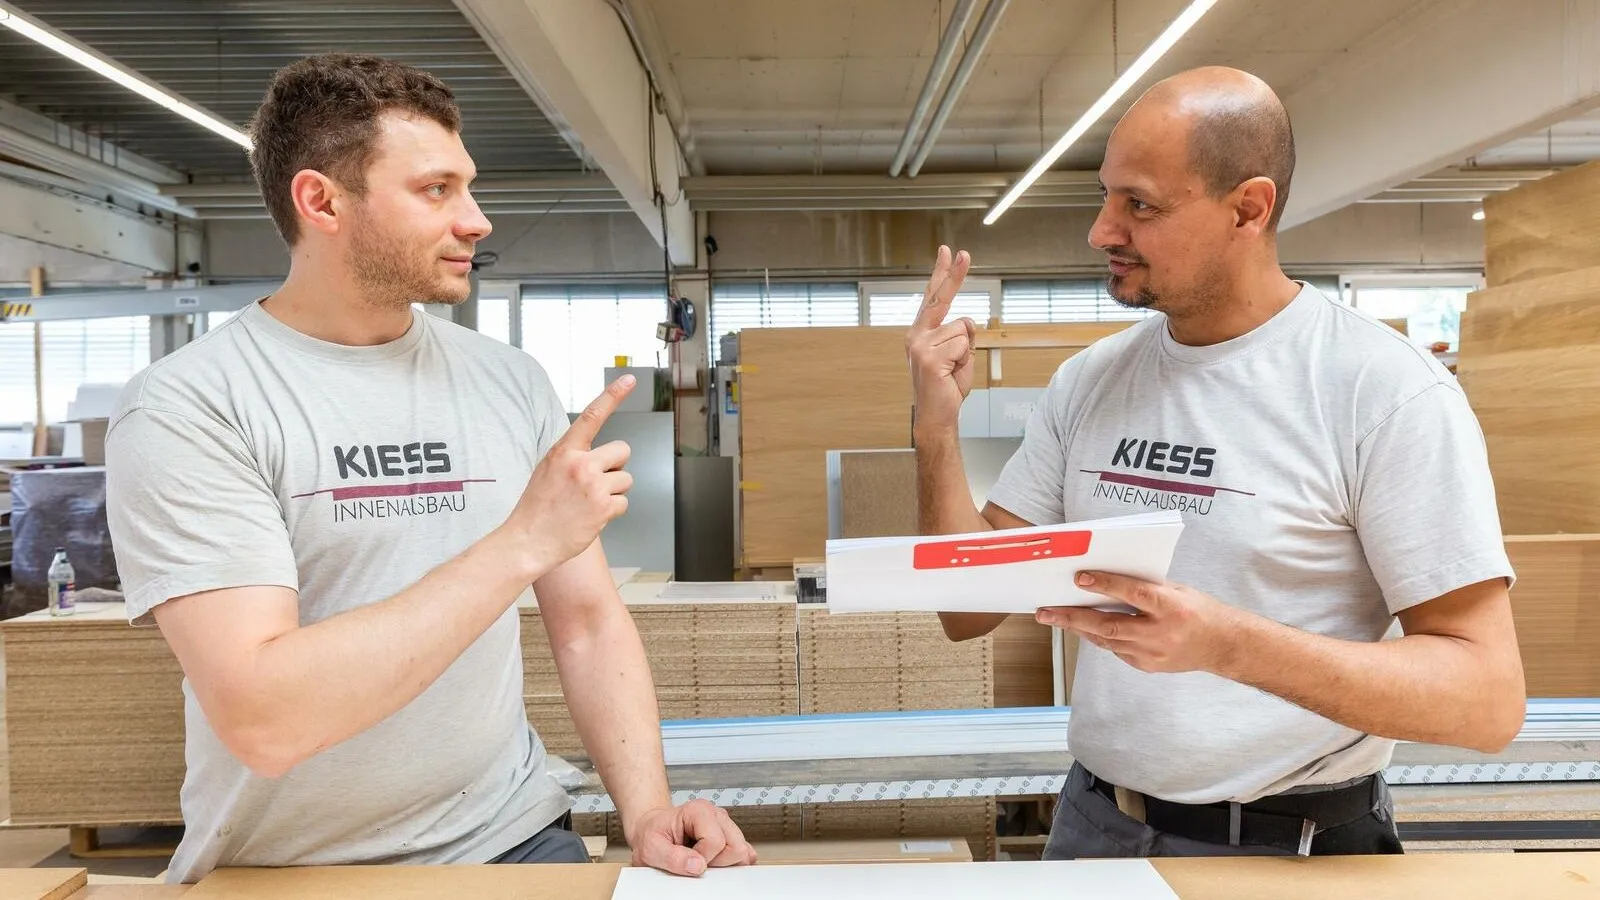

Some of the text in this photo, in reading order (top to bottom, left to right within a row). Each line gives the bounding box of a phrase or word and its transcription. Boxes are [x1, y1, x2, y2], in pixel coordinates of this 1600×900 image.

[334, 442, 451, 479] KIESS
[1111, 438, 1217, 478] KIESS
[334, 494, 466, 522] INNENAUSBAU
[1093, 483, 1213, 515] INNENAUSBAU
